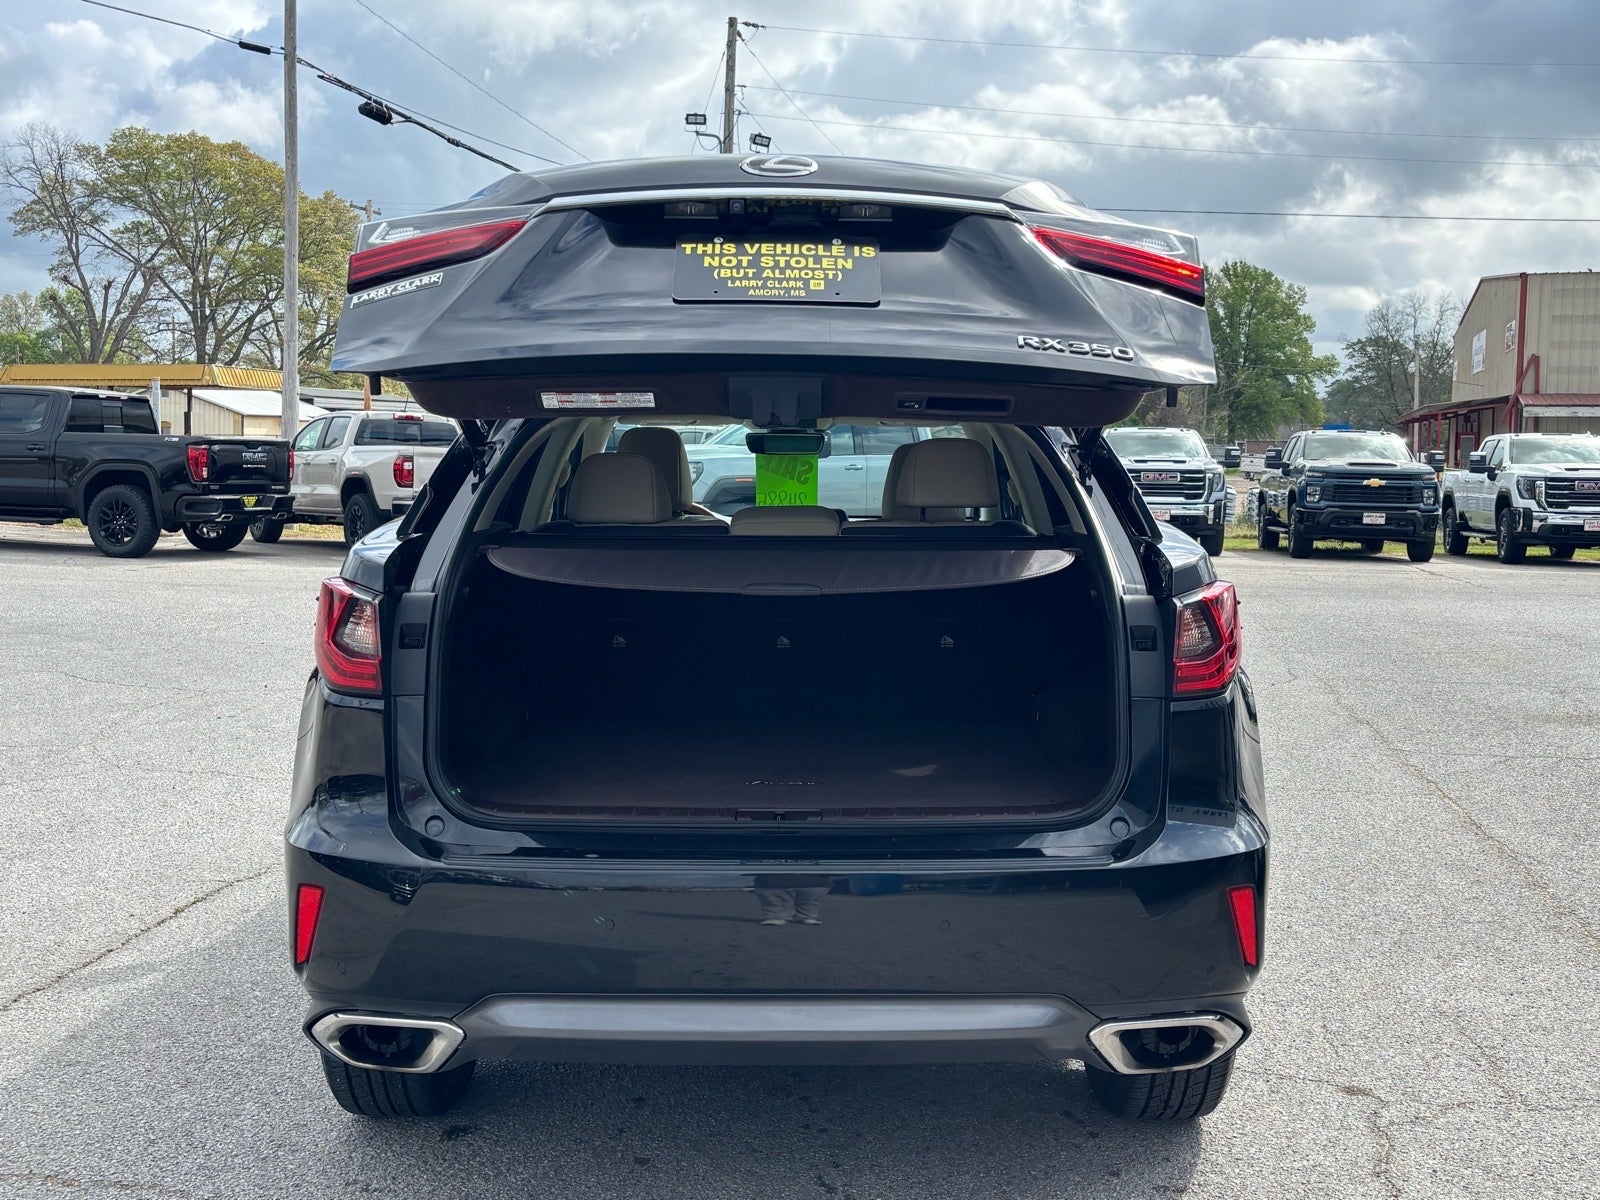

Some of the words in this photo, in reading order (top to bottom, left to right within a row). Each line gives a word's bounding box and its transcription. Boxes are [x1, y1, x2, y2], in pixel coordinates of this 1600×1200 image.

[681, 243, 737, 255] THIS
[744, 243, 846, 257] VEHICLE
[853, 246, 876, 258] IS
[703, 256, 752, 268] NOT
[759, 256, 853, 270] STOLEN
[713, 268, 756, 280] (BUT
[761, 269, 843, 282] ALMOST)
[353, 285, 395, 304] LARRY
[396, 273, 440, 291] CLARK
[727, 280, 764, 288] LARRY
[766, 280, 804, 288] CLARK
[748, 289, 788, 297] AMORY,
[1143, 472, 1179, 481] GMC
[1578, 482, 1600, 490] GM
